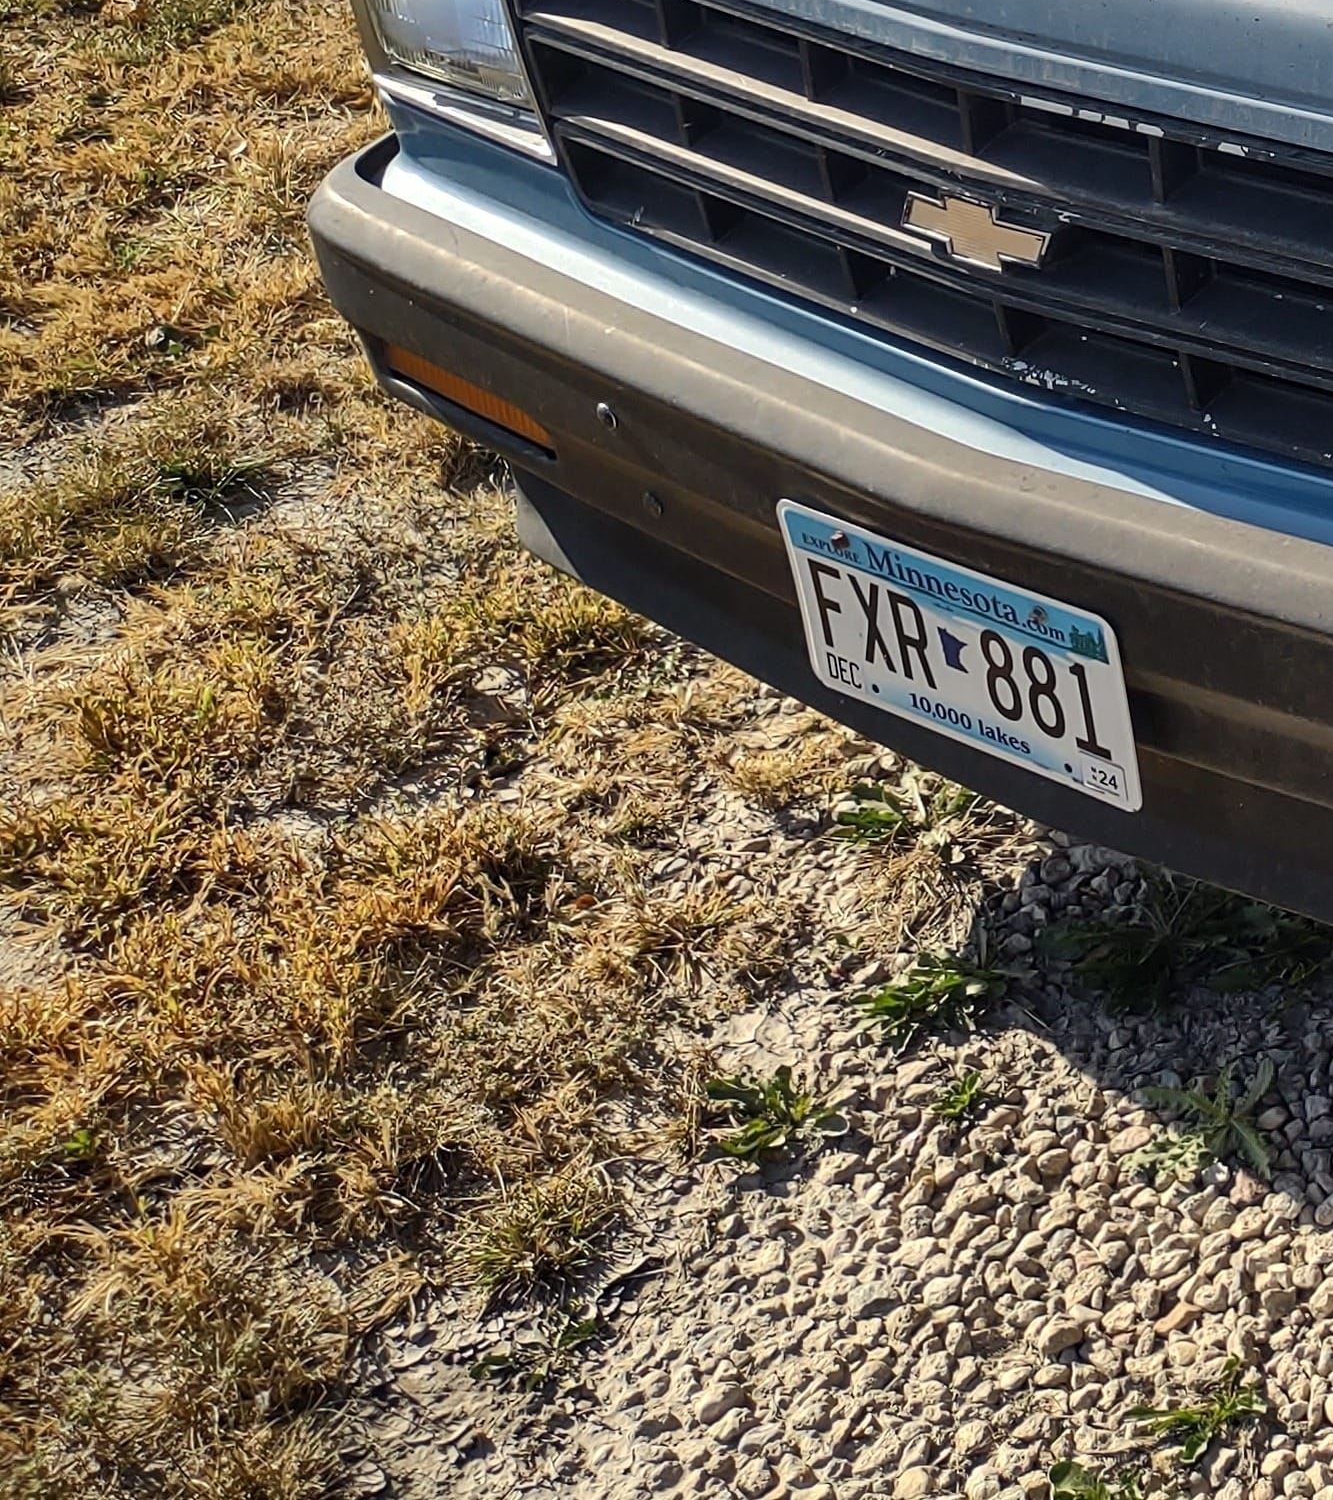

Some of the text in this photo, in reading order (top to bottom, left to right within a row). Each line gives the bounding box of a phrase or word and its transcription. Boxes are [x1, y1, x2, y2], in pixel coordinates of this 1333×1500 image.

[807, 558, 1112, 761] FXR 881
[826, 652, 862, 690] DEC
[908, 692, 1031, 755] 10,000 lakes
[1098, 770, 1118, 790] 24
